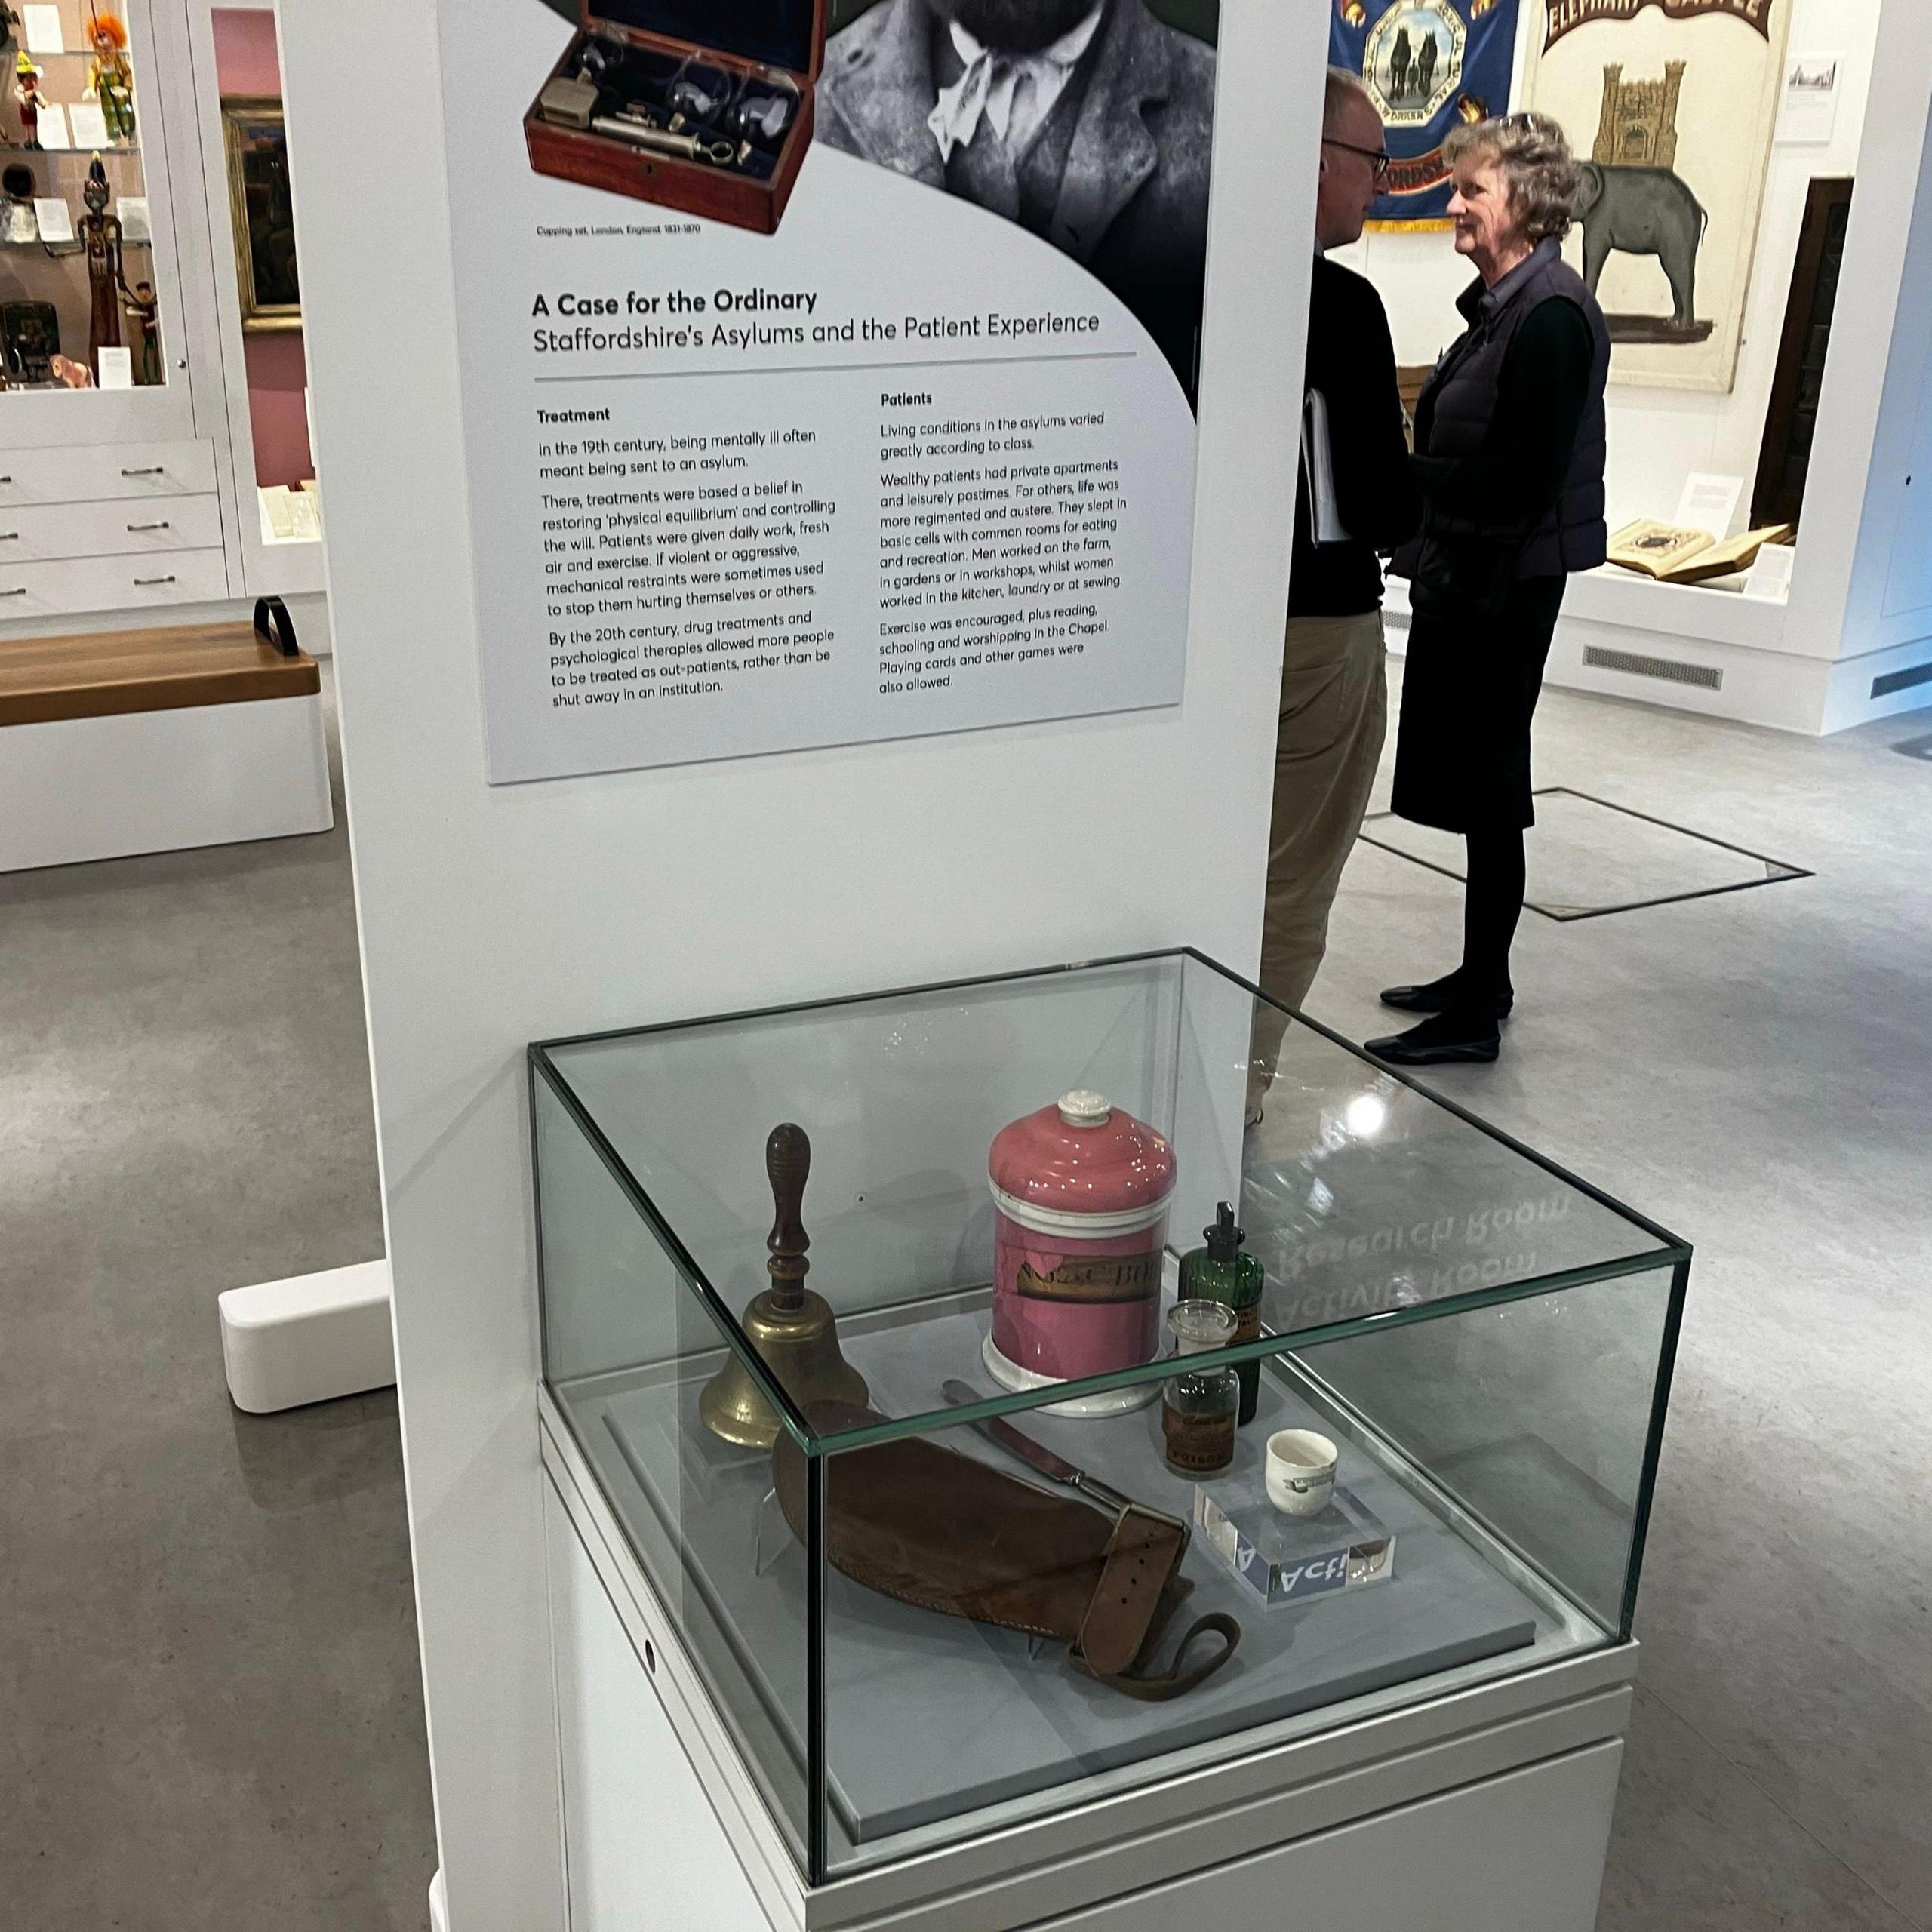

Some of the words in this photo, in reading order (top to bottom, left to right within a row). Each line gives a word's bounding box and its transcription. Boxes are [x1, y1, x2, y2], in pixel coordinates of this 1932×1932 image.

[537, 226, 573, 238] Cupping
[531, 294, 550, 318] A
[558, 293, 619, 317] Case
[626, 290, 660, 315] for
[667, 289, 706, 314] the
[714, 287, 817, 315] Ordinary
[534, 324, 703, 353] Staffordshire's
[712, 321, 804, 351] Asylums
[812, 318, 854, 343] and
[862, 317, 897, 341] the
[905, 315, 980, 339] Patient
[988, 312, 1099, 340] Experience
[881, 392, 932, 407] Patients
[536, 407, 610, 424] Treatment
[881, 424, 916, 440] Living
[920, 420, 981, 435] conditions
[985, 418, 995, 432] in
[998, 417, 1017, 432] the
[1020, 414, 1066, 431] asylums
[1069, 411, 1104, 426] varied
[539, 443, 551, 457] In
[555, 441, 577, 456] the
[582, 438, 610, 454] 19th
[614, 438, 666, 454] century,
[670, 435, 706, 452] being
[711, 431, 766, 448] mentally
[770, 429, 779, 445] ill
[783, 429, 816, 444] often
[540, 463, 584, 479] meant
[589, 461, 626, 478] being
[630, 460, 657, 474] sent
[662, 459, 675, 472] to
[679, 460, 696, 471] an
[700, 454, 748, 472] asylum.
[880, 471, 930, 488] Wealthy
[934, 469, 981, 487] patients
[985, 465, 1007, 480] had
[1011, 464, 1050, 481] private
[1054, 459, 1118, 477] apartments
[541, 494, 583, 509] There,
[586, 490, 660, 507] treatments
[663, 490, 694, 502] were
[698, 483, 737, 500] based
[742, 486, 750, 497] a
[754, 480, 789, 496] belief
[792, 480, 803, 494] in
[880, 493, 903, 508] and
[907, 490, 954, 506] leisurely
[958, 488, 1011, 506] pastimes.
[1016, 484, 1034, 498] For
[1037, 482, 1075, 497] others,
[1078, 478, 1094, 494] life
[1097, 480, 1119, 492] was
[543, 515, 601, 531] restoring
[606, 509, 662, 530] 'physical
[666, 505, 738, 525] equilibrium'
[742, 503, 766, 518] and
[771, 500, 835, 516] controlling
[544, 538, 566, 553] the
[570, 536, 595, 551] will.
[599, 533, 653, 549] Patients
[657, 533, 688, 545] were
[691, 529, 725, 546] given
[729, 525, 759, 541] daily
[763, 521, 795, 537] work,
[800, 519, 829, 535] fresh
[880, 534, 911, 549] basic
[915, 531, 940, 546] cells
[943, 528, 968, 543] with
[971, 528, 1022, 540] common
[1026, 525, 1060, 537] rooms
[1064, 519, 1079, 533] for
[1082, 518, 1117, 532] eating
[545, 560, 563, 574] air
[567, 556, 592, 573] and
[597, 555, 651, 571] exercise.
[656, 552, 664, 566] If
[668, 549, 710, 565] violent
[715, 551, 728, 562] or
[732, 543, 799, 563] aggressive,
[880, 576, 890, 589] in
[894, 572, 940, 590] gardens
[944, 572, 956, 583] or
[960, 569, 970, 582] in
[973, 565, 1035, 580] workshops,
[1038, 559, 1069, 574] whilst
[1074, 558, 1113, 571] women
[546, 576, 623, 595] mechanical
[627, 574, 687, 589] restraints
[691, 572, 721, 584] were
[724, 566, 792, 582] sometimes
[795, 560, 823, 576] used
[547, 604, 561, 617] to
[566, 602, 595, 617] stop
[598, 598, 632, 613] them
[636, 595, 681, 609] hurting
[686, 588, 755, 605] themselves
[759, 589, 772, 599] or
[776, 583, 817, 598] others.
[549, 632, 566, 648] By
[570, 629, 592, 644] the
[595, 626, 626, 642] 20th
[629, 625, 679, 638] century,
[684, 620, 712, 635] drug
[717, 614, 784, 632] treatments
[788, 610, 811, 625] and
[880, 620, 926, 636] Exercise
[930, 620, 952, 632] was
[955, 609, 1025, 628] encouraged,
[1029, 608, 1051, 623] plus
[1054, 604, 1097, 618] reading,
[550, 645, 639, 669] psychological
[644, 641, 703, 659] therapies
[706, 635, 754, 652] allowed
[758, 635, 789, 648] more
[793, 629, 834, 648] people
[880, 660, 921, 675] Playing
[925, 655, 956, 669] cards
[960, 651, 982, 666] and
[985, 650, 1015, 663] other
[1018, 647, 1055, 662] games
[1058, 644, 1084, 655] were
[552, 675, 565, 688] to
[569, 672, 586, 685] be
[590, 666, 637, 683] treated
[641, 668, 656, 678] as
[660, 658, 740, 678] out-patients,
[743, 654, 780, 669] rather
[784, 652, 811, 665] than
[816, 649, 830, 662] be
[879, 680, 903, 694] also
[906, 674, 952, 691] allowed.
[553, 693, 580, 707] shut
[584, 691, 620, 704] away
[623, 688, 635, 700] in
[638, 688, 655, 699] an
[659, 681, 723, 697] institution.
